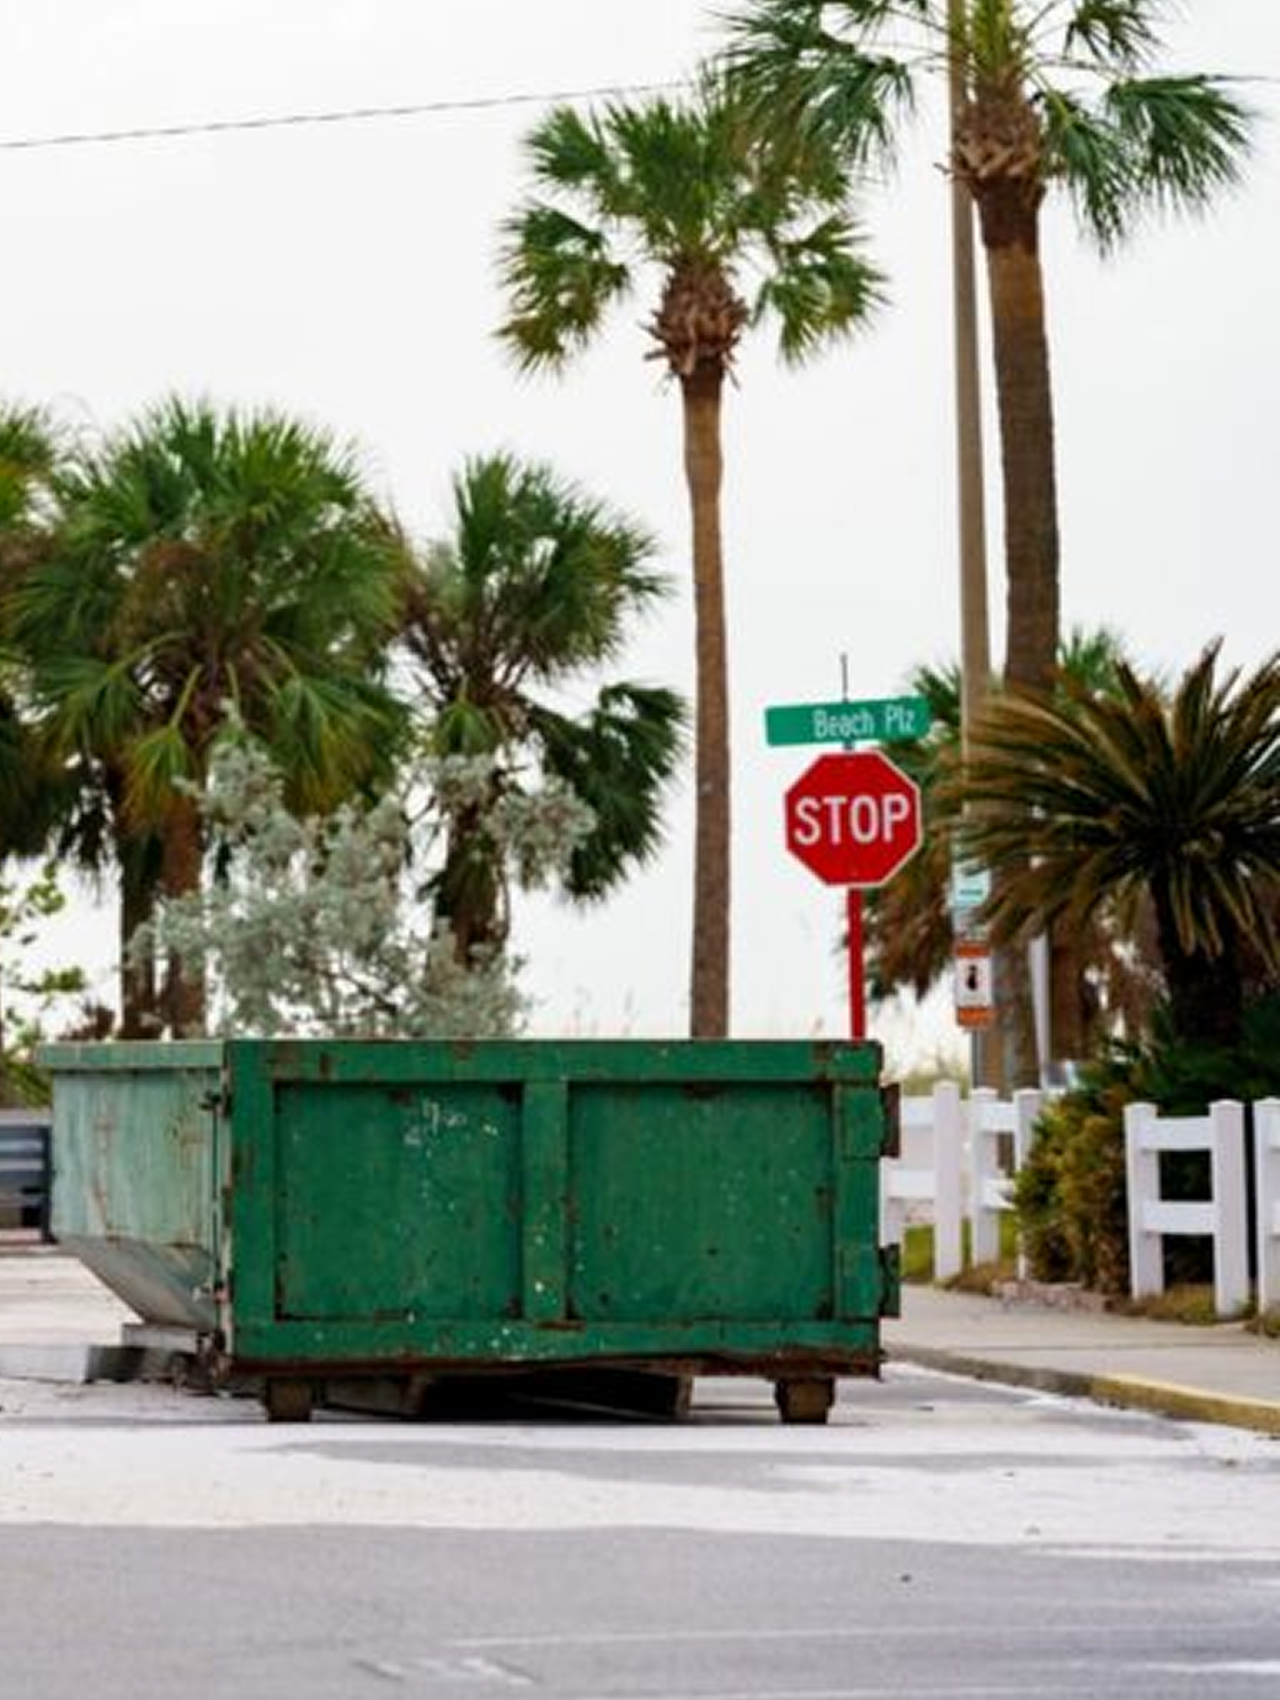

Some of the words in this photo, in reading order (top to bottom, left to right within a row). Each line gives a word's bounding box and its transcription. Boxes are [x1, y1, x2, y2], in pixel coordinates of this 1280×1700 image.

[813, 707, 875, 738] Beach
[884, 703, 916, 734] Plz
[794, 793, 911, 845] STOP
